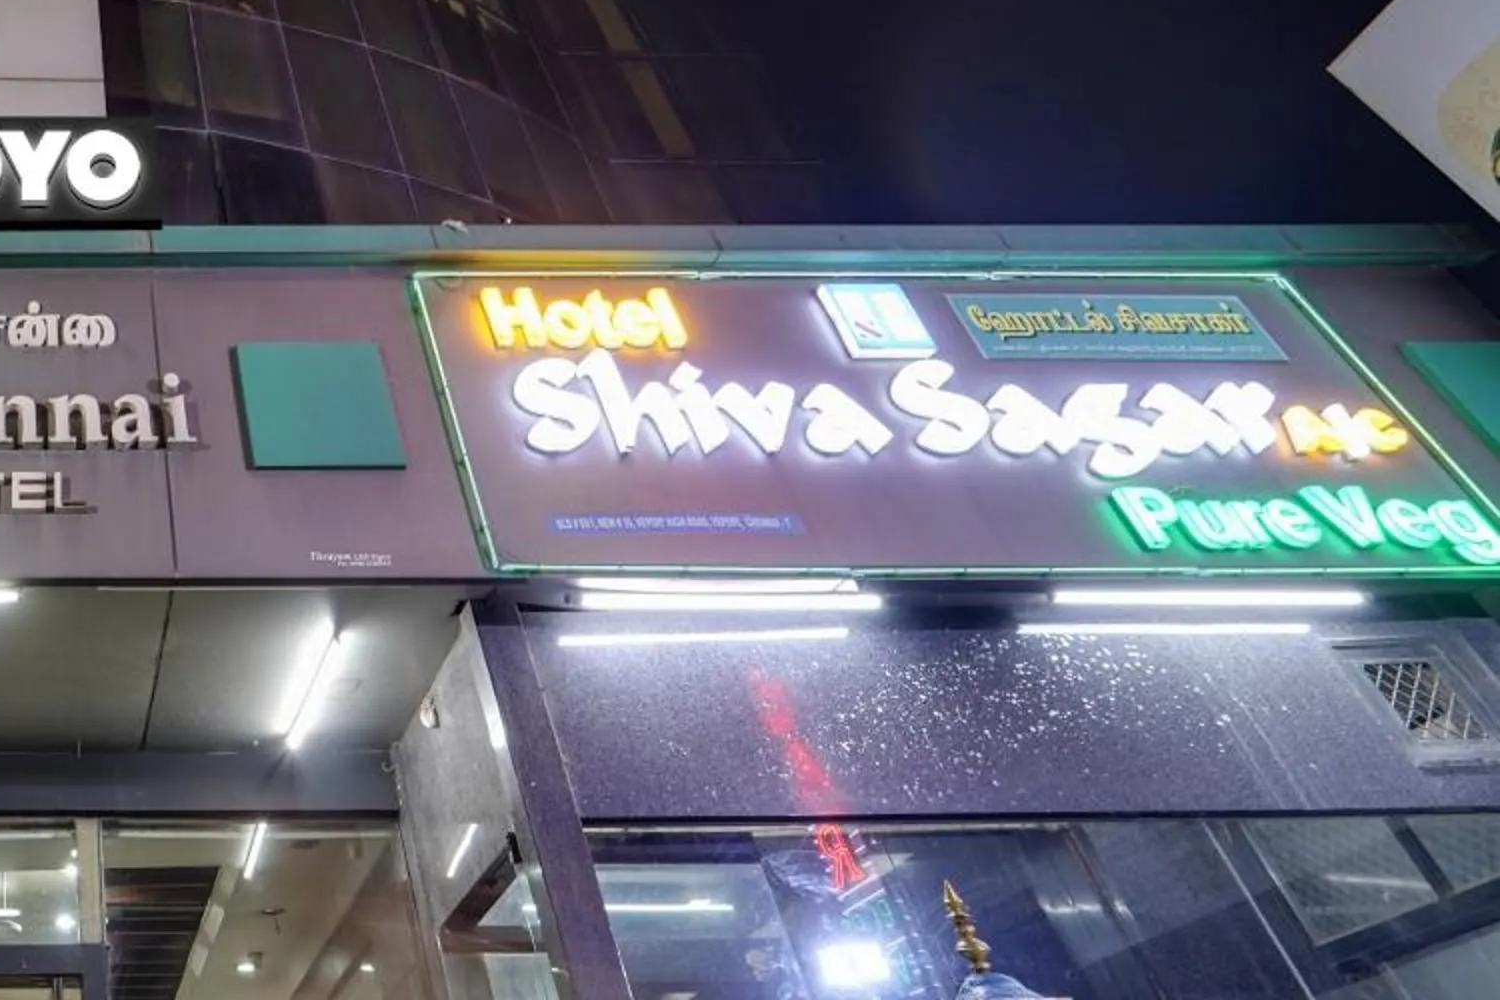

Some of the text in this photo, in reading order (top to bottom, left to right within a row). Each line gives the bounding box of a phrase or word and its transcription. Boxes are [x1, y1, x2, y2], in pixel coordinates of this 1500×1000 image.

[479, 286, 688, 349] Hotel
[512, 347, 895, 456] Shiva
[889, 358, 1277, 479] Sagar
[1109, 485, 1323, 550] Pure
